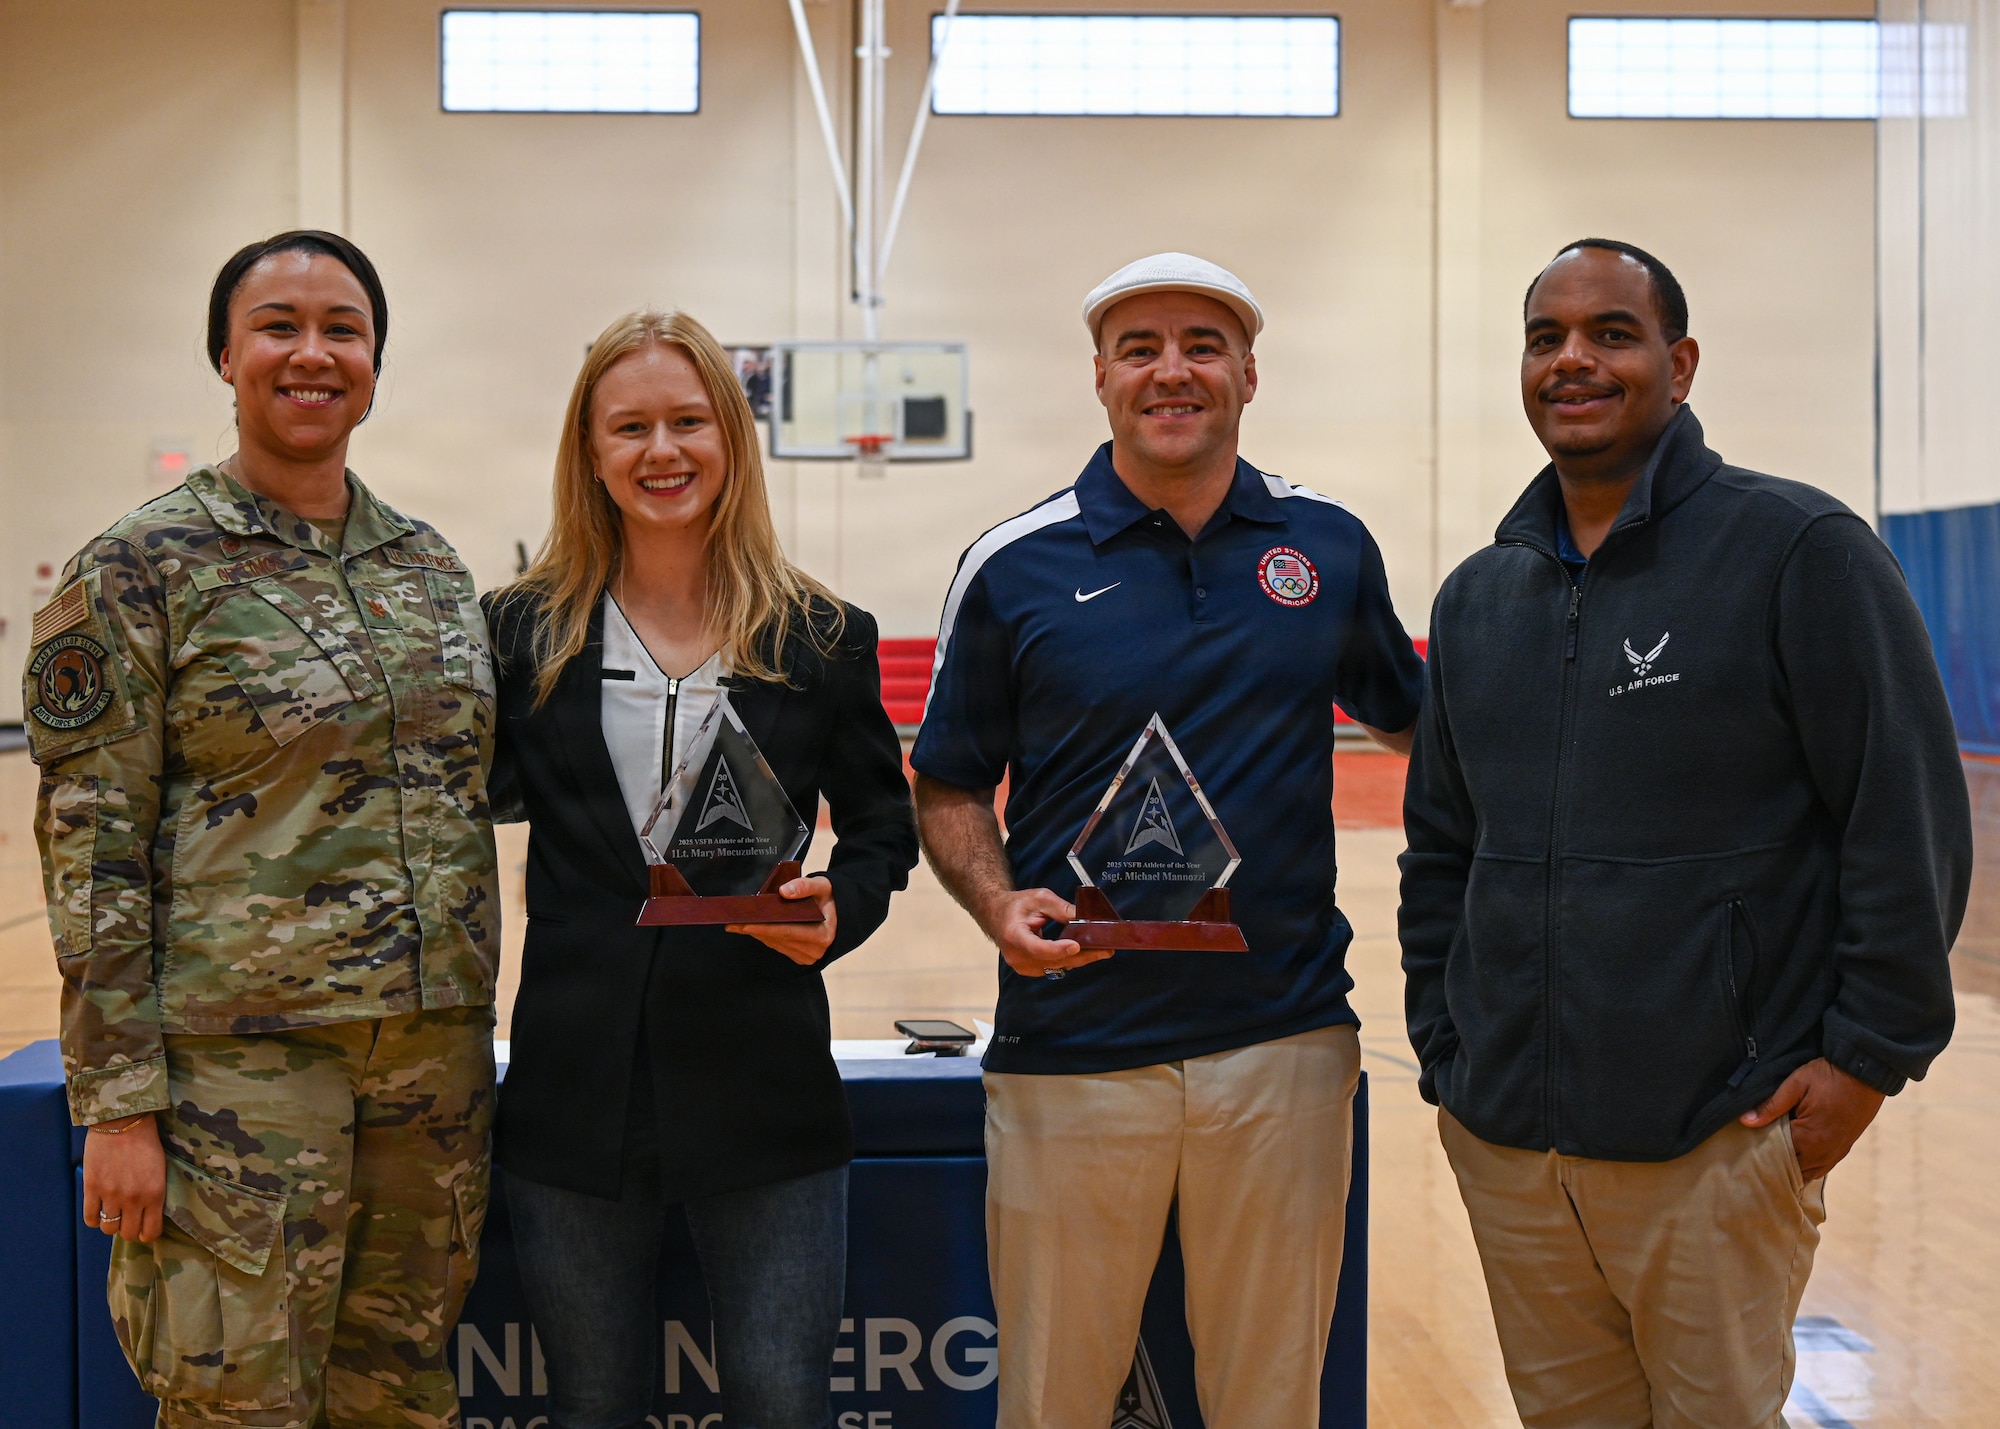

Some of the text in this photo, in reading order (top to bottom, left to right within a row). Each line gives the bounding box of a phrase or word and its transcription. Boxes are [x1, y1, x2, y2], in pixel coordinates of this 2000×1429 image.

[426, 553, 460, 571] FORCE
[1260, 547, 1311, 566] UNITED STATES
[1260, 579, 1319, 606] PAN AMERICAN TEAM
[34, 637, 101, 671] LEAD DEVELOP SERVE
[1609, 673, 1680, 697] U.S. AIR FORCE
[35, 693, 110, 727] 30TH FORCE SUPPORT SQ
[691, 848, 715, 859] Mary
[1142, 861, 1166, 869] Athlete
[1166, 861, 1175, 869] of
[1174, 861, 1185, 869] the
[1101, 871, 1206, 883] Ssgt. Michael Mannozzi
